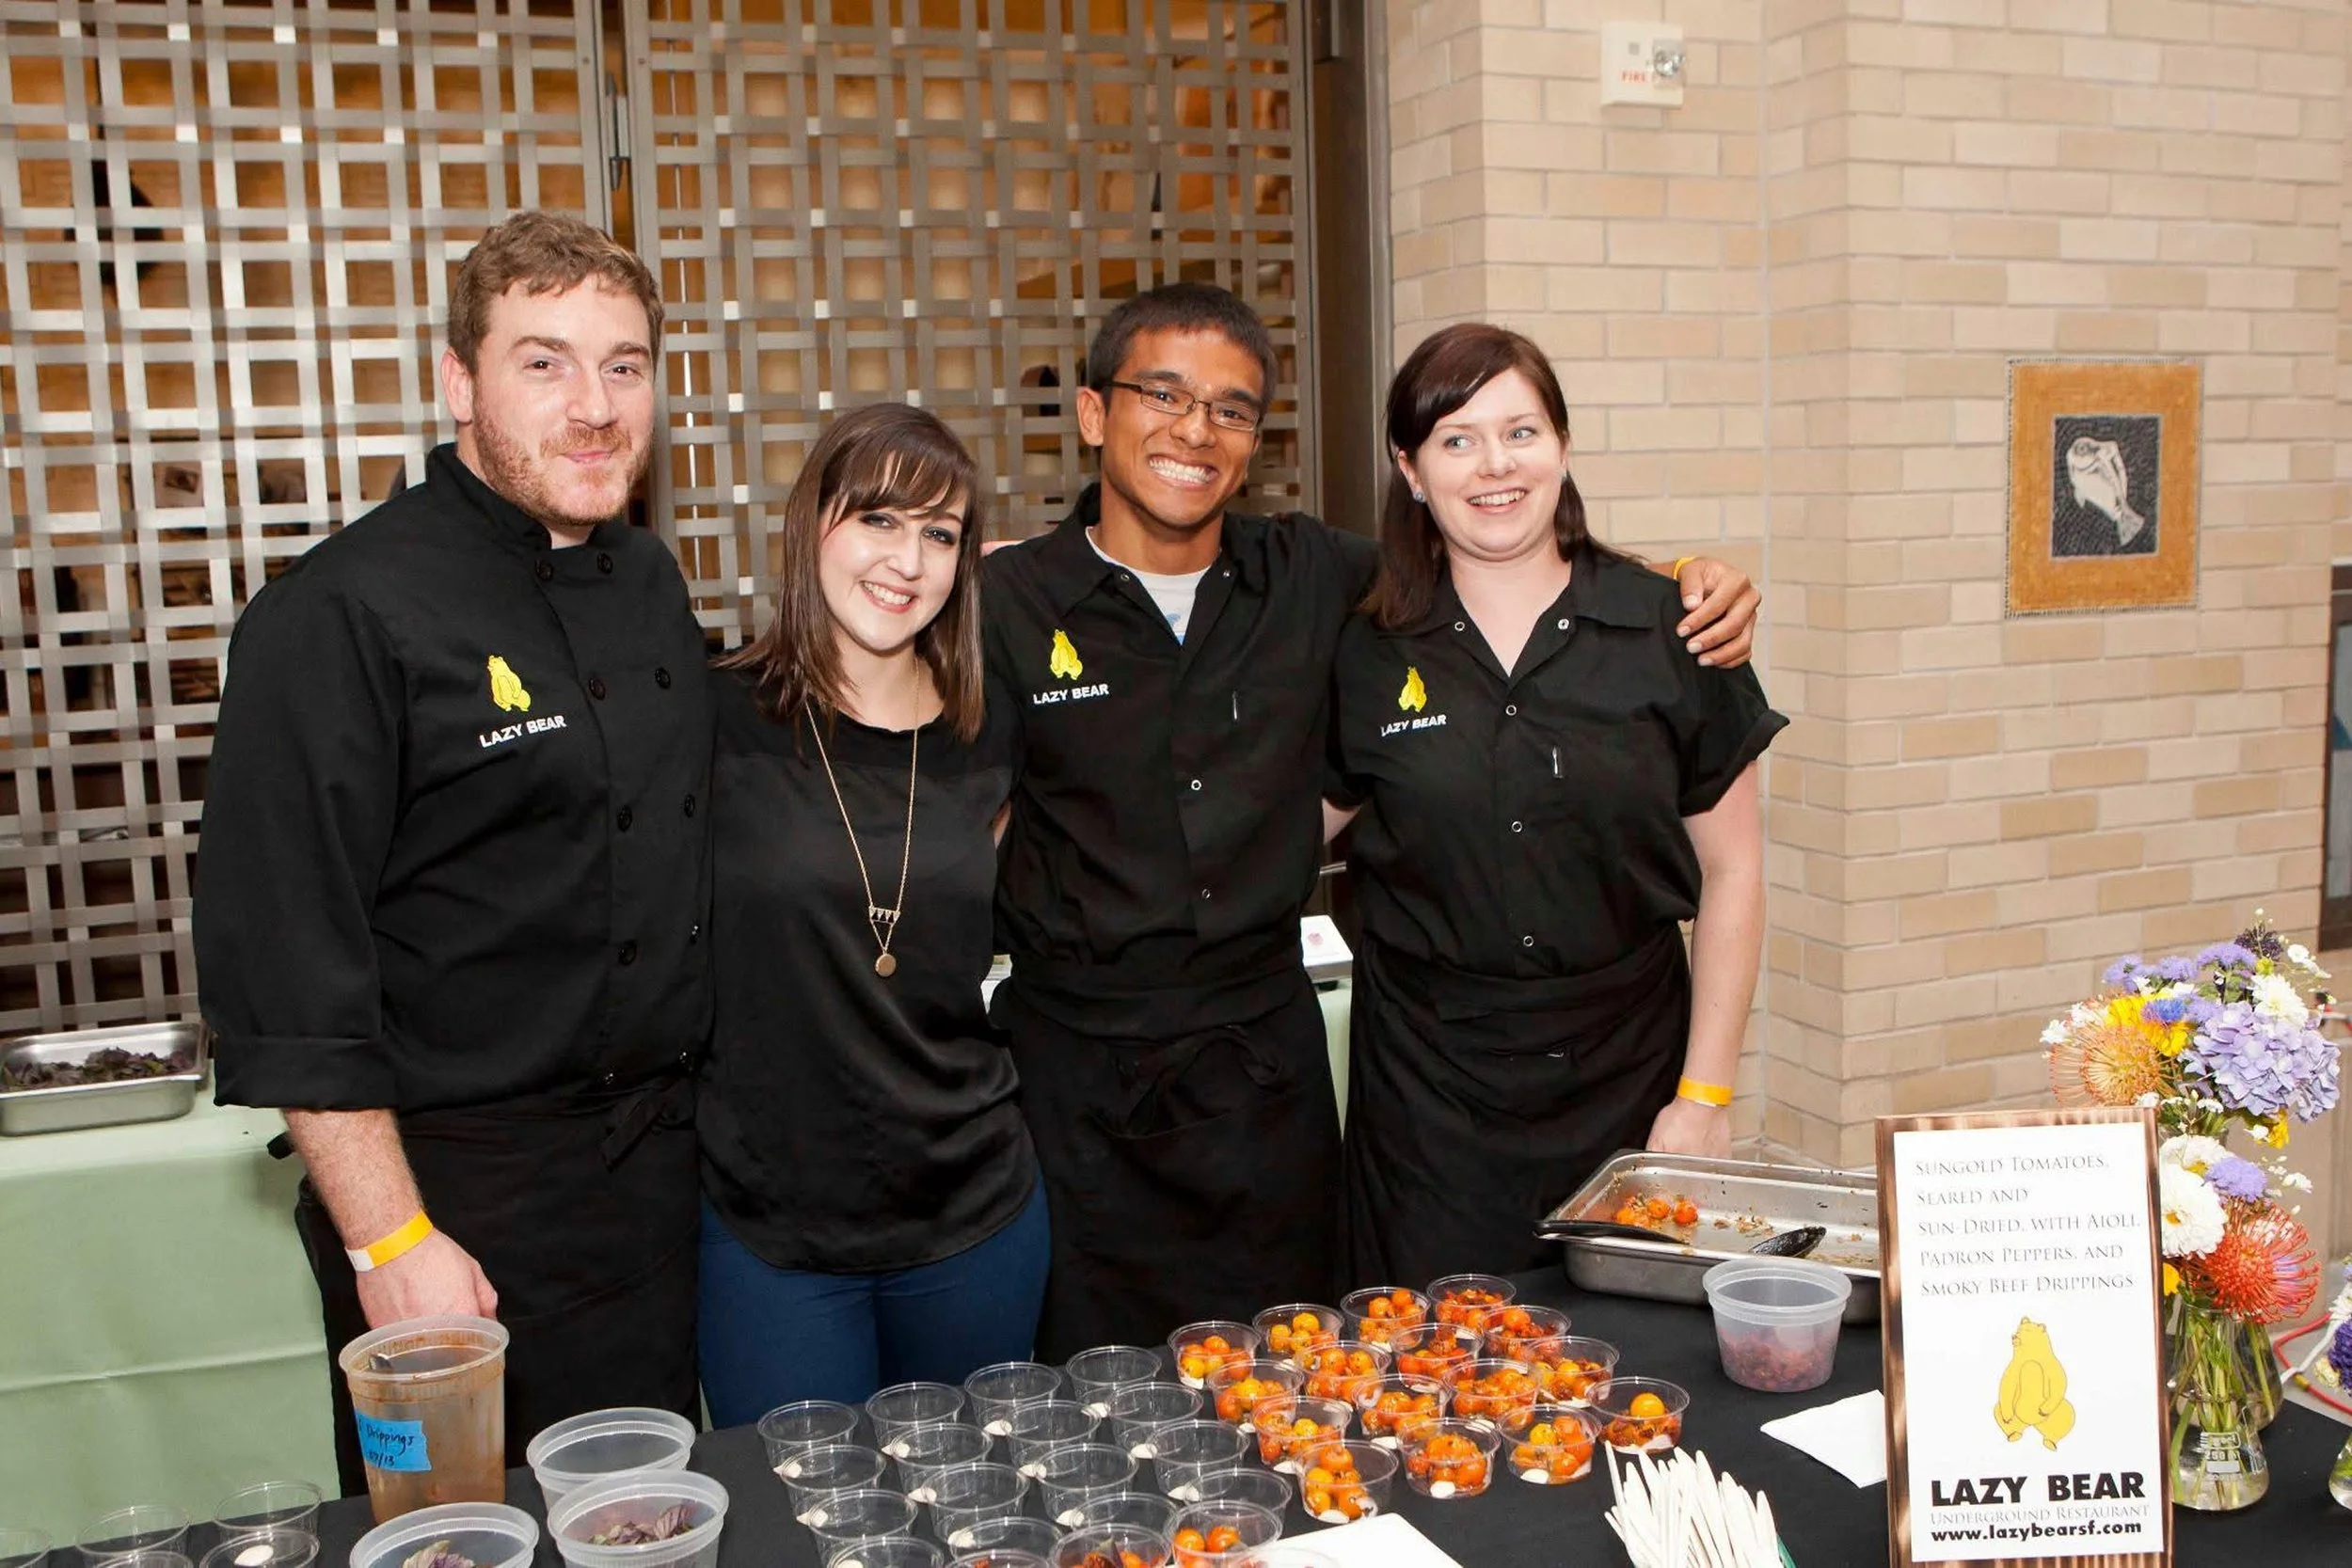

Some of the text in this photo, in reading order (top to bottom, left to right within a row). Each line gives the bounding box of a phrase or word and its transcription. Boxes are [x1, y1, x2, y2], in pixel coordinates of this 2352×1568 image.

[1033, 684, 1109, 705] LAZY BEAR
[479, 715, 566, 748] LAZY BEAR
[1380, 714, 1447, 736] LAZY BEAR
[1990, 1188, 2028, 1204] AND
[2031, 1215, 2079, 1231] WITH
[1920, 1249, 1994, 1266] PADRON
[2085, 1244, 2123, 1259] AND
[1921, 1274, 2134, 1296] SMOKY BEEF DRIPPINGS
[366, 1424, 414, 1456] Drippings
[1931, 1472, 2145, 1506] LAZY BEAR
[1931, 1505, 2150, 1525] UNDERGROUND RESTAURANT
[1931, 1520, 2141, 1542] www.lazybearsf.com
